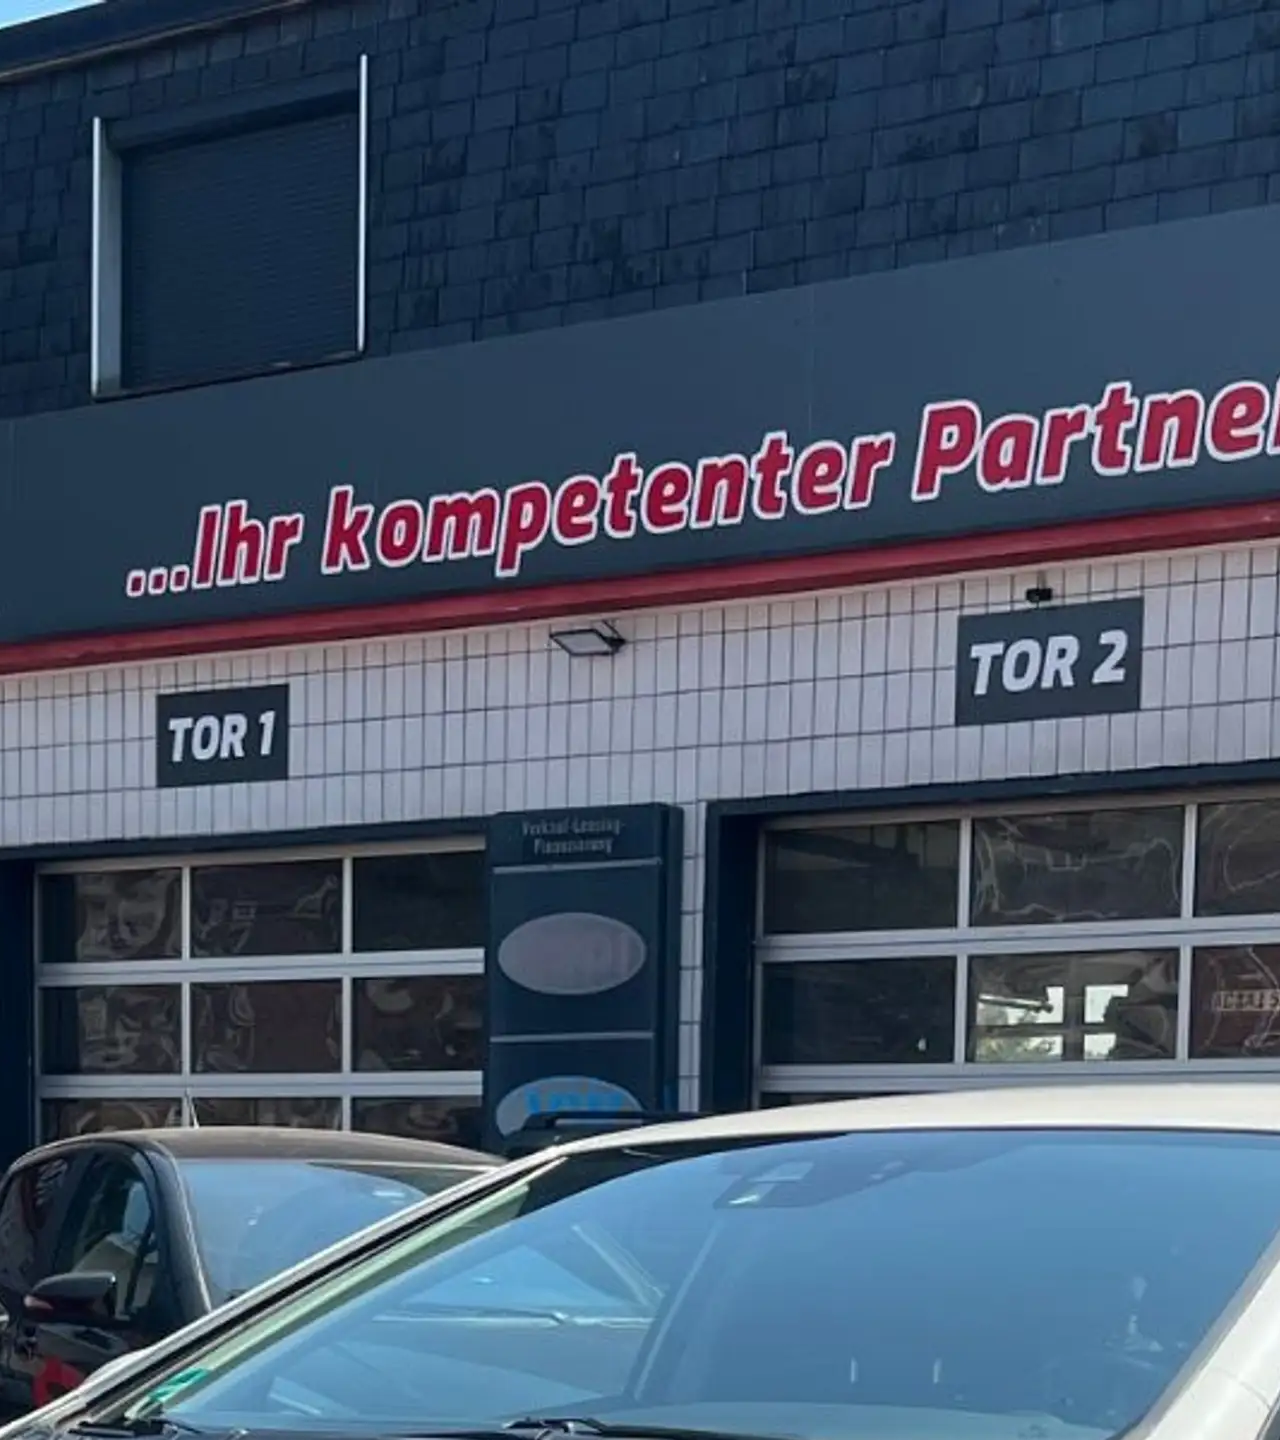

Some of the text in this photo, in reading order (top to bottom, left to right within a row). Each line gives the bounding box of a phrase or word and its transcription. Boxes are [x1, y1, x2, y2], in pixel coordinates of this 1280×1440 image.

[319, 431, 894, 578] kompetenter
[970, 629, 1127, 696] TOR 2
[169, 710, 275, 763] TOR 1
